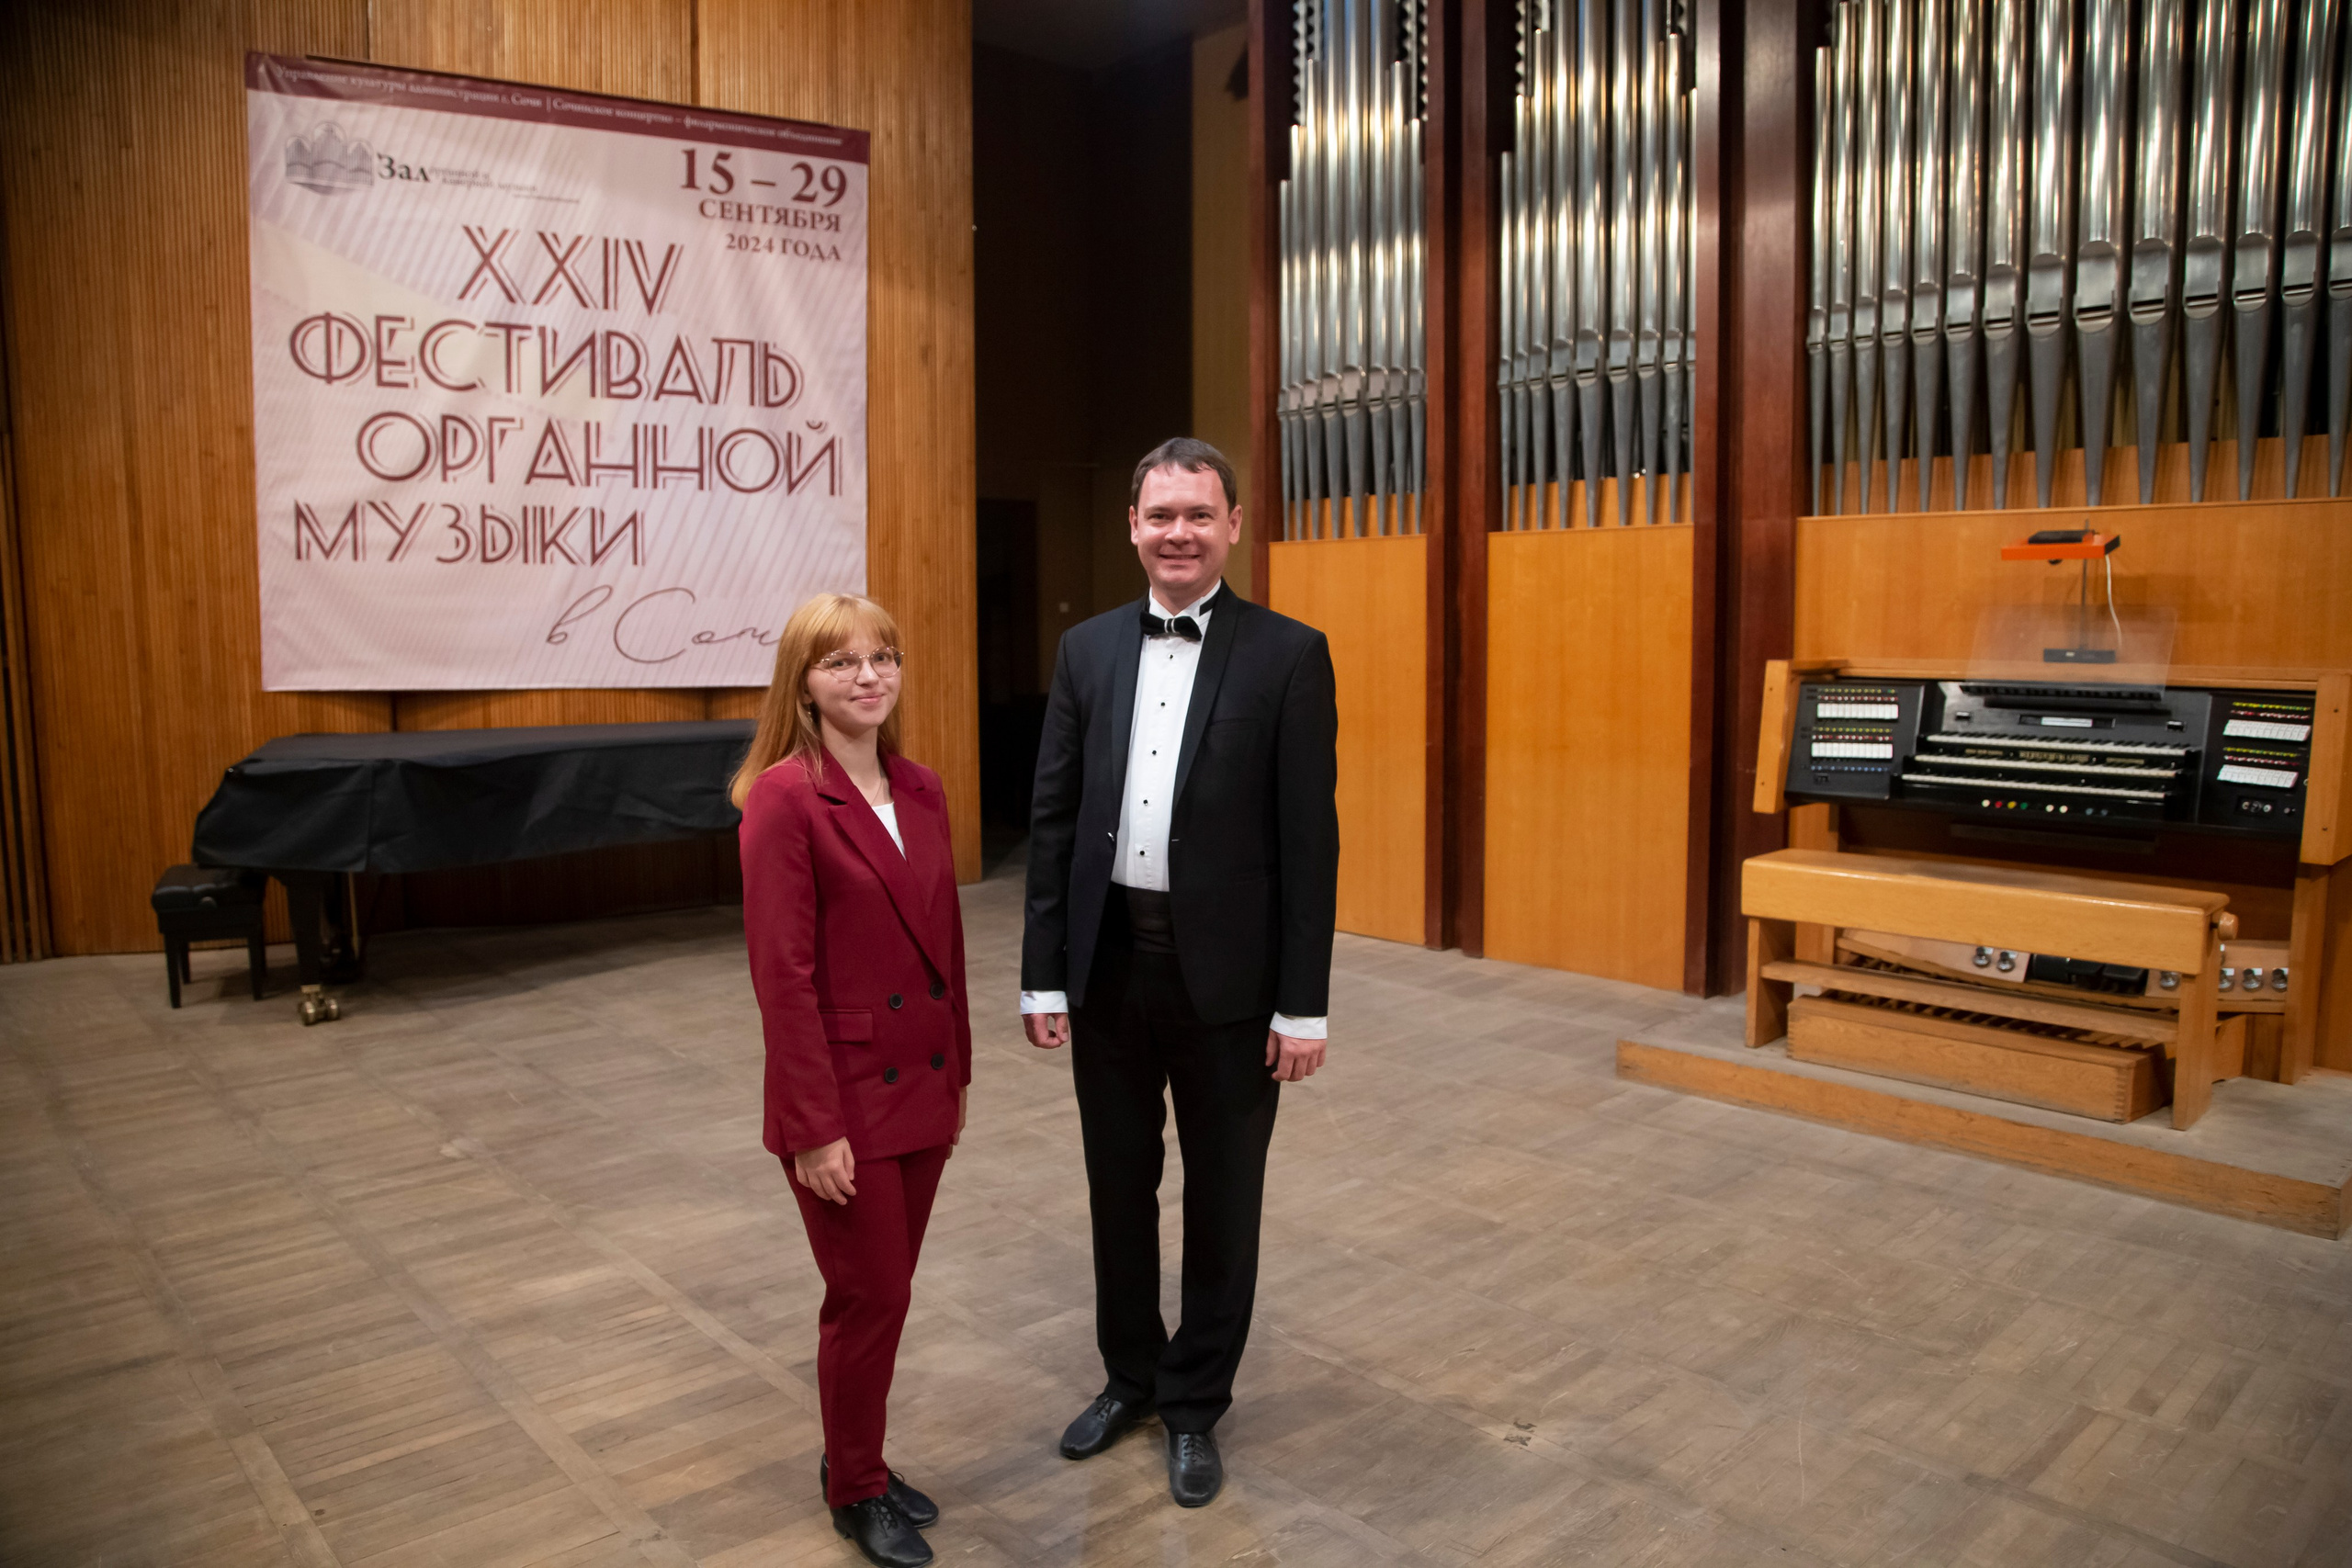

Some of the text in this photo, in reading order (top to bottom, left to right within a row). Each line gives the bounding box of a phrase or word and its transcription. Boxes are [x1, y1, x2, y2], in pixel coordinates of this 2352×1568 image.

[511, 93, 542, 107] Сочи
[552, 97, 614, 117] Сочинское
[615, 108, 673, 124] концертно
[377, 152, 430, 183] Зал
[681, 148, 734, 196] 15
[791, 161, 847, 208] 29
[698, 197, 841, 232] СЕНТЯБРЯ
[458, 223, 684, 316] XXIV
[726, 233, 841, 262] 2024 ГОДА
[289, 311, 805, 409] ФЕСТИВАЛЬ
[356, 411, 843, 497] ОРГАННОЙ
[293, 501, 645, 567] МУЗЫКИ
[546, 584, 781, 664] в Соч
